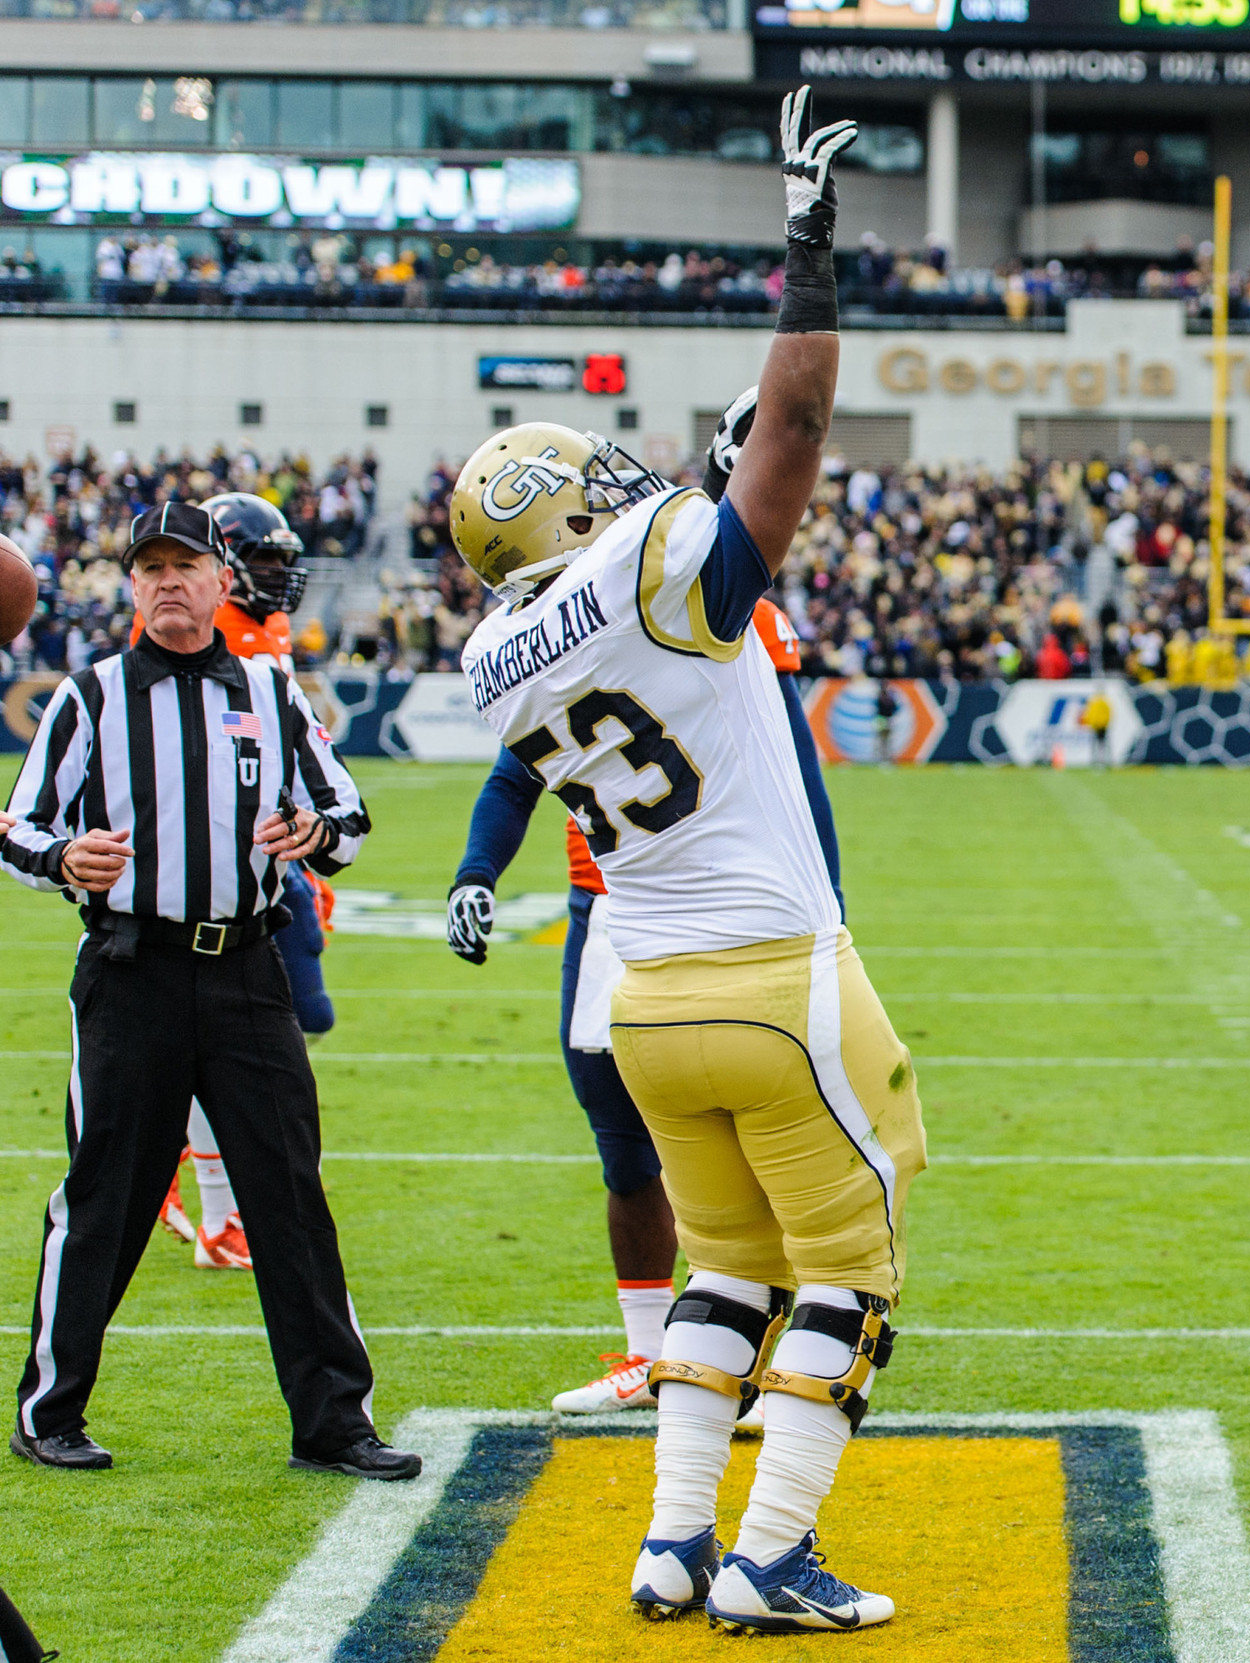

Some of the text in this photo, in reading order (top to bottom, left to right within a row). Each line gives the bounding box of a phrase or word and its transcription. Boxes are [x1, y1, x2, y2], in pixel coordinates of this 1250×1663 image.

[801, 47, 952, 79] NATIONAL
[964, 49, 1147, 84] CHAMPIONS
[878, 346, 1177, 410] Georgia
[484, 534, 503, 556] ACC
[238, 756, 260, 788] U
[504, 687, 704, 857] 53
